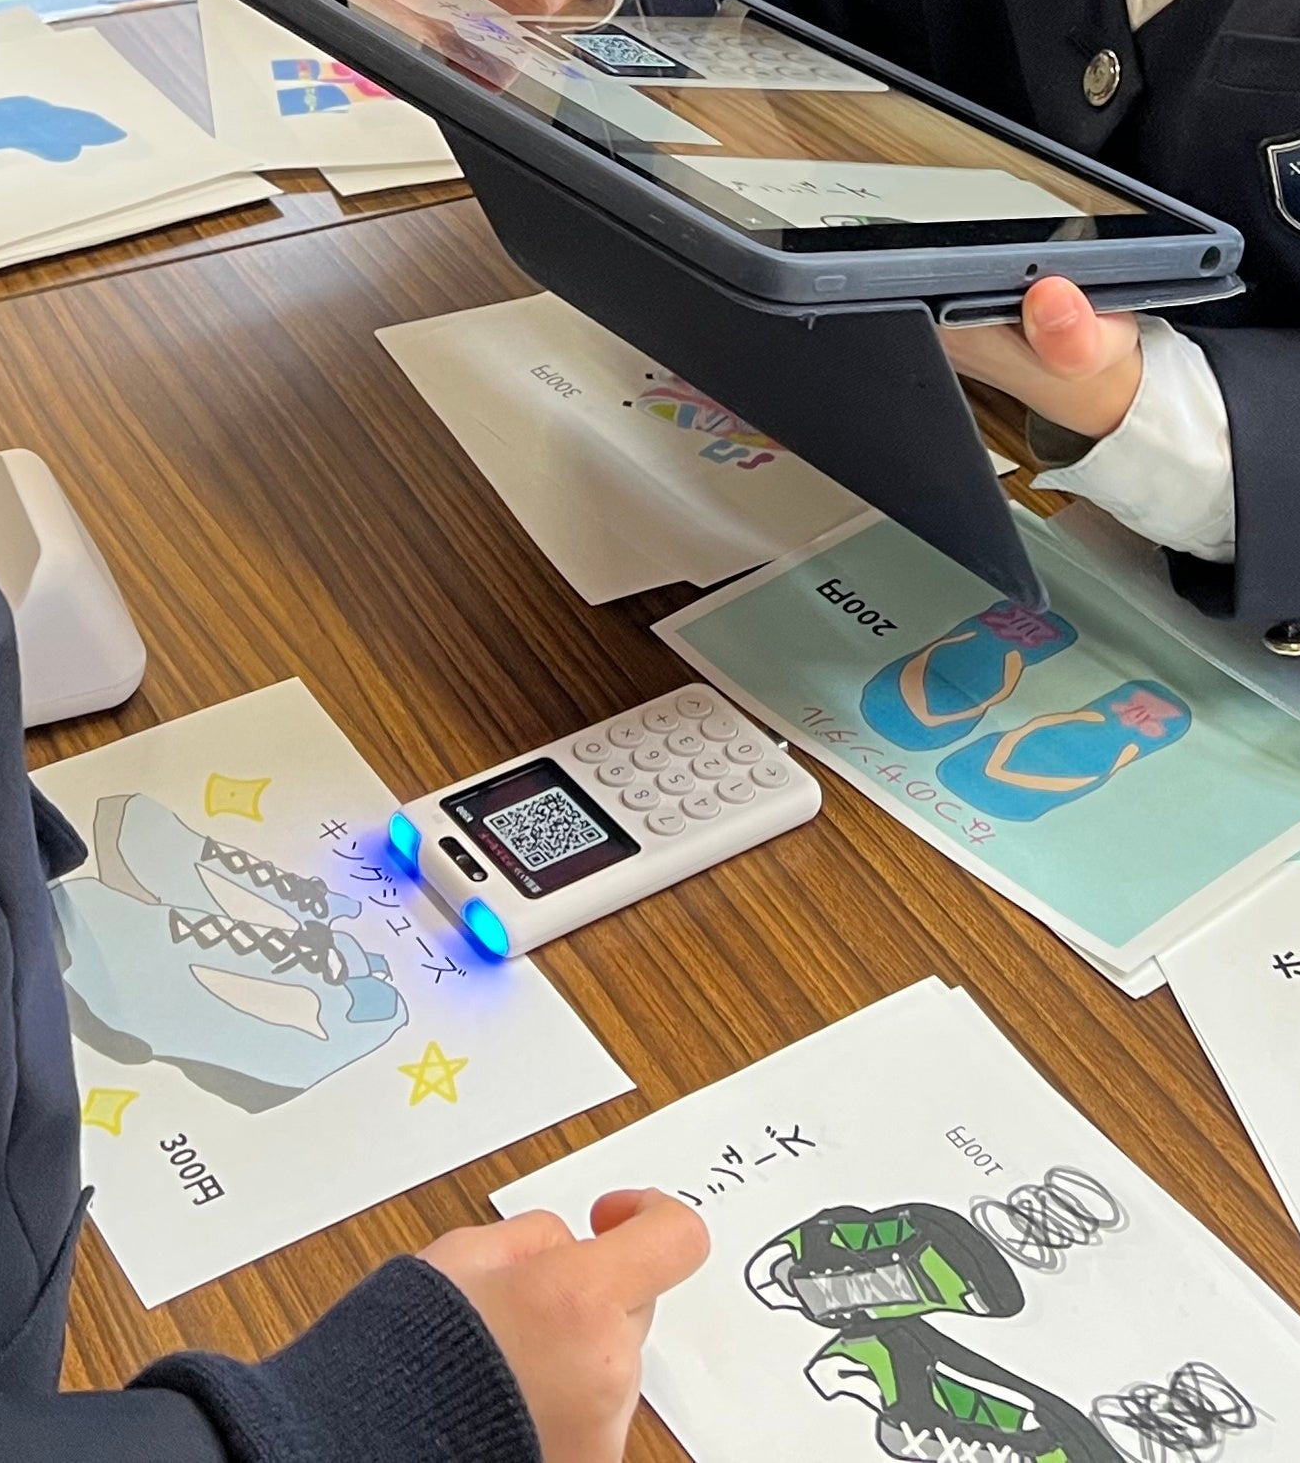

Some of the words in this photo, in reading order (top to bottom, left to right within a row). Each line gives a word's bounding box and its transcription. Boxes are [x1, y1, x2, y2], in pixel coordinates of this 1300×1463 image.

[530, 363, 583, 400] 300円
[815, 577, 899, 639] 200円
[800, 704, 997, 848] なつのサンダル
[318, 819, 467, 985] キングシューズ
[160, 1131, 227, 1208] 300円
[944, 1125, 1005, 1179] 100円
